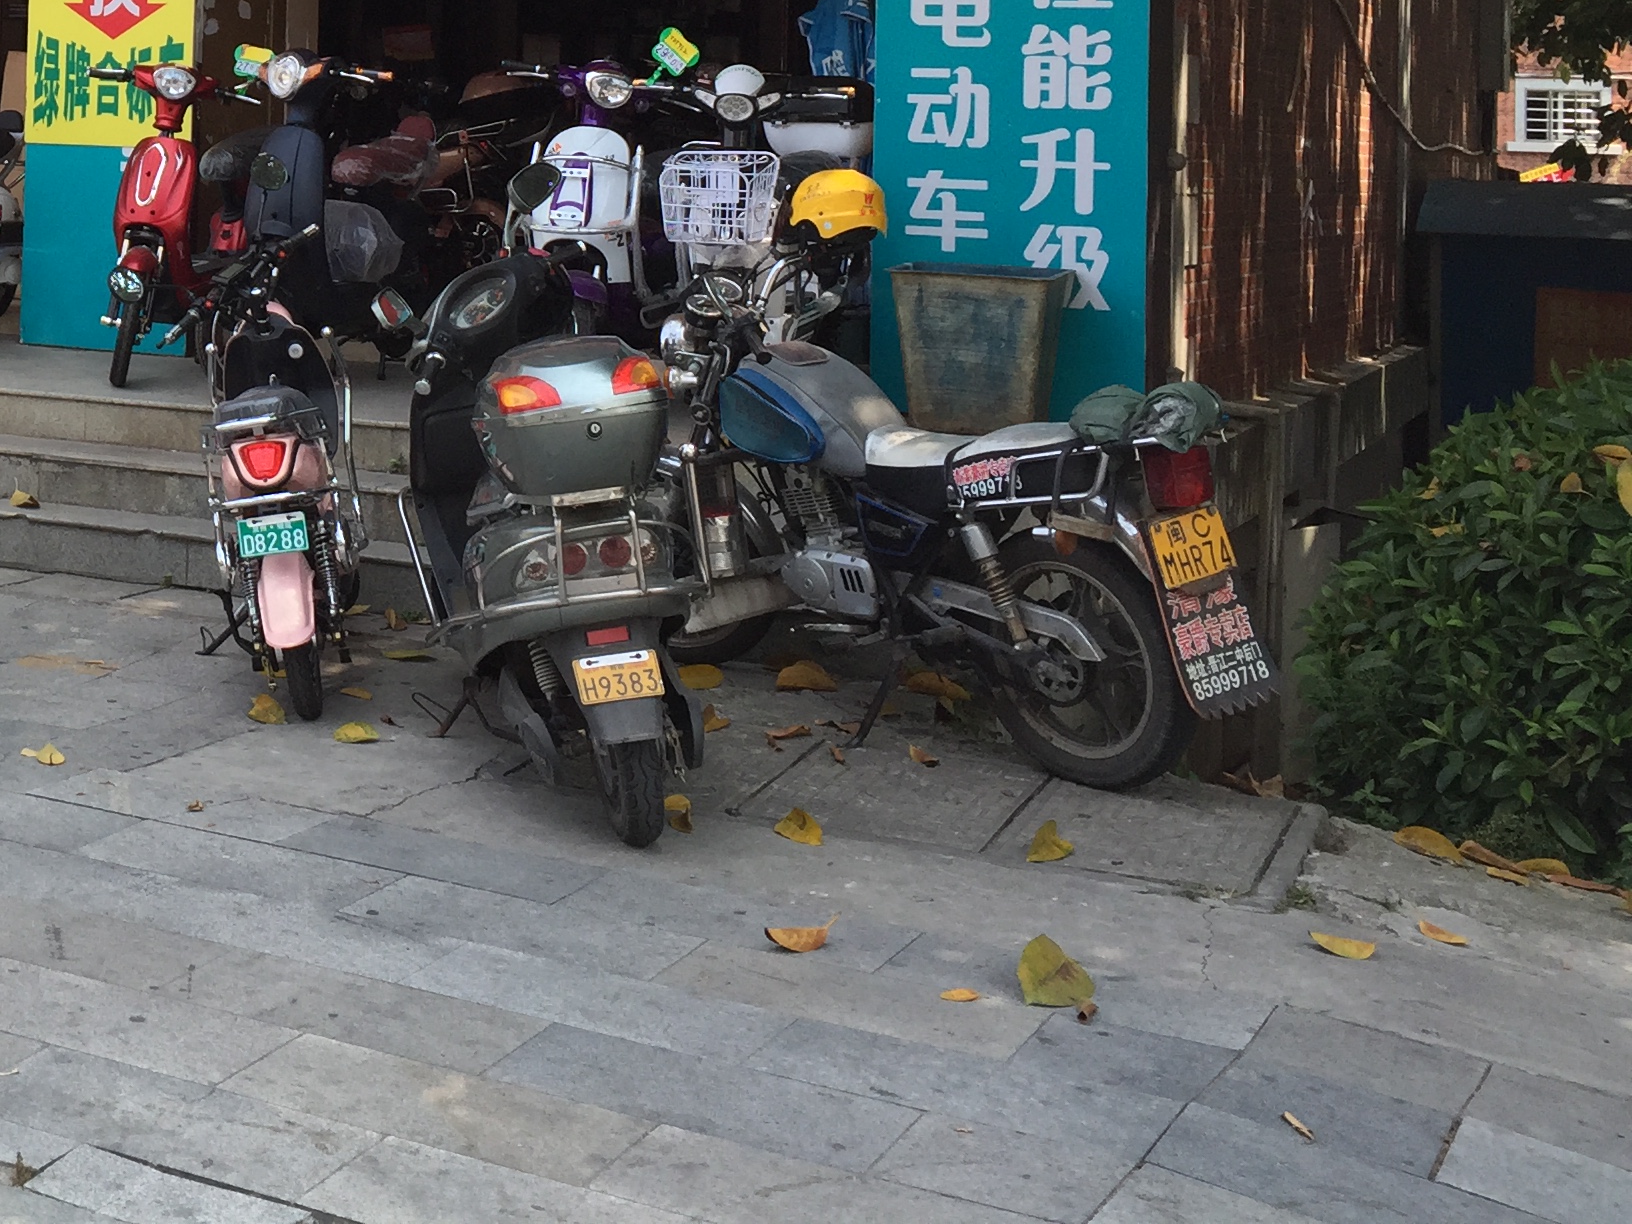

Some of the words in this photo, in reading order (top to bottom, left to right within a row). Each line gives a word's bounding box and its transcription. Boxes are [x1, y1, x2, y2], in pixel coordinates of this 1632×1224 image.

[243, 528, 305, 555] D8288
[582, 668, 659, 701] H9383
[1192, 659, 1270, 702] 85999718
